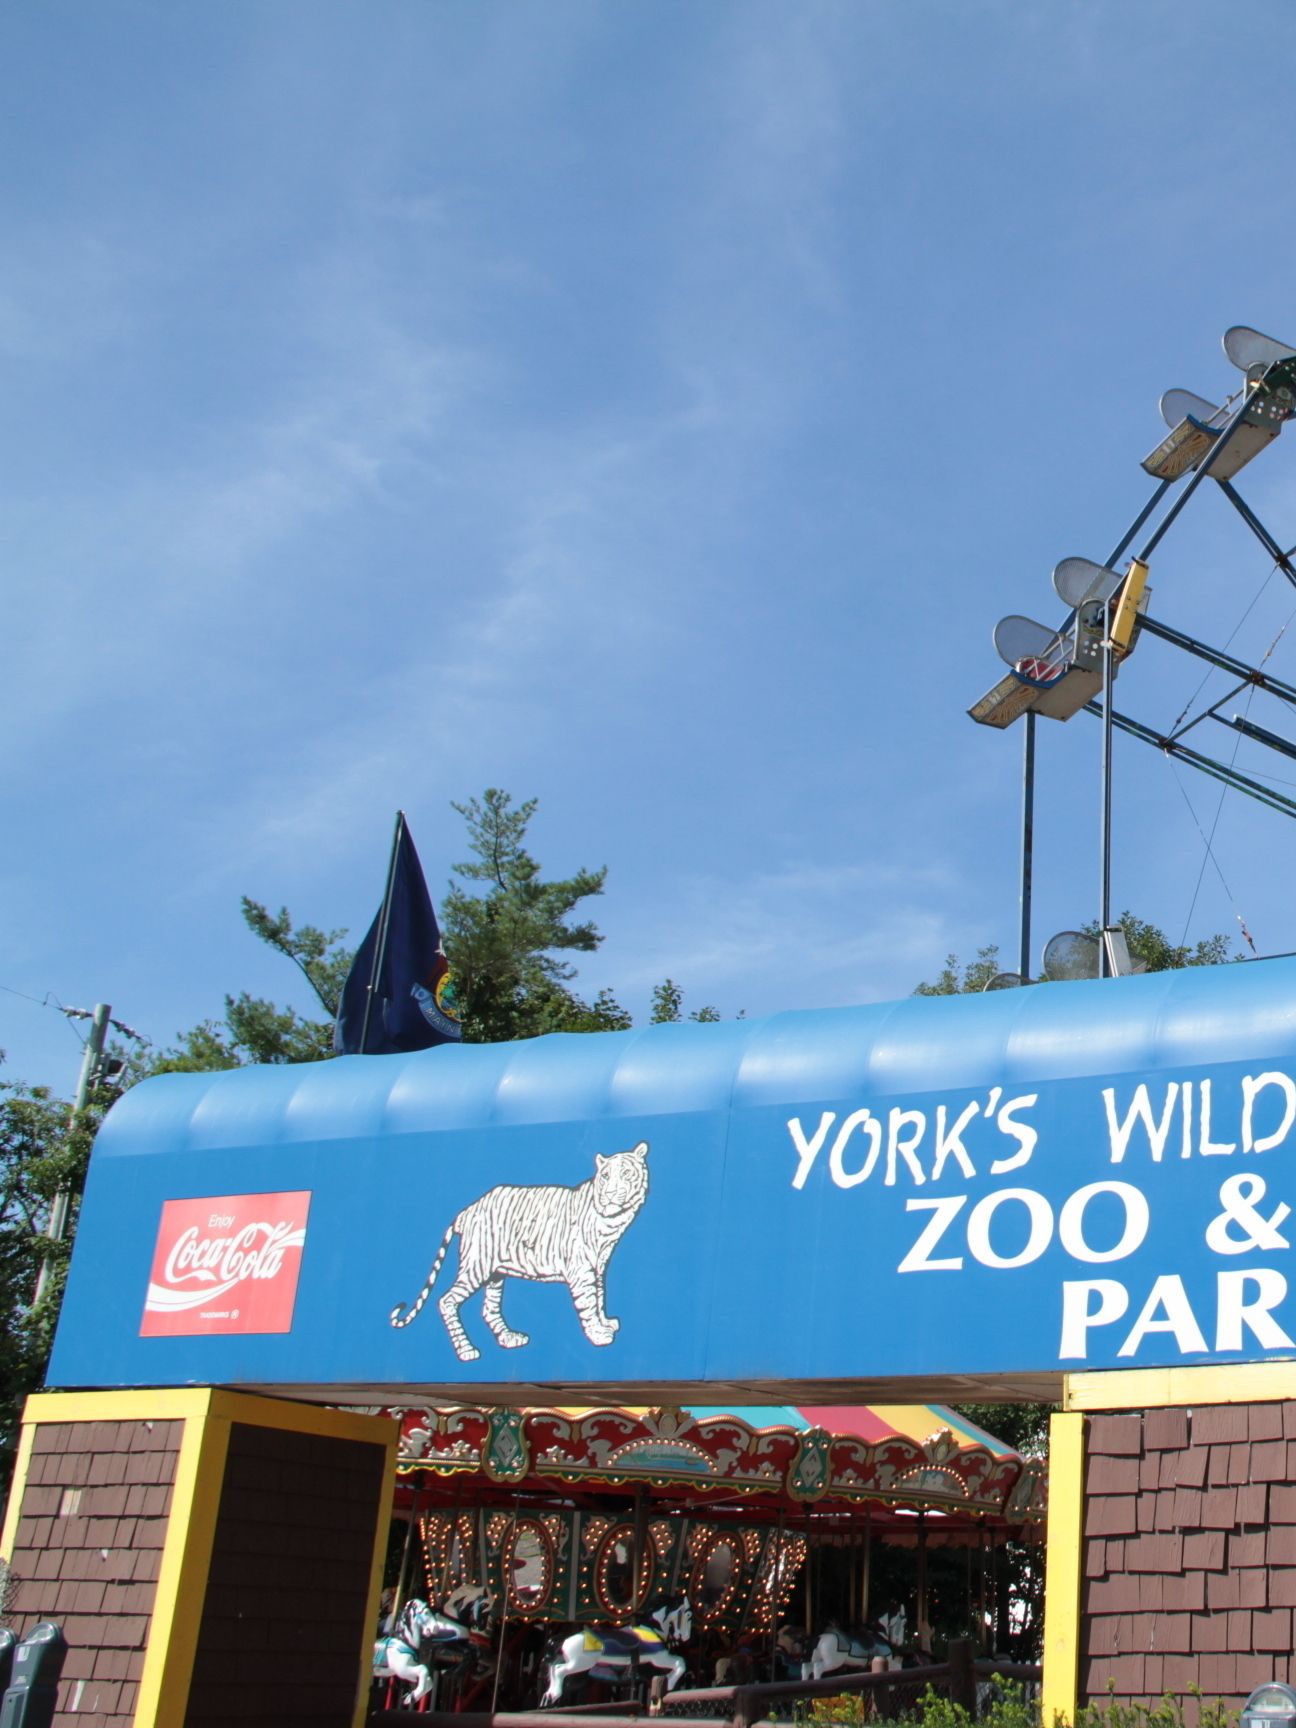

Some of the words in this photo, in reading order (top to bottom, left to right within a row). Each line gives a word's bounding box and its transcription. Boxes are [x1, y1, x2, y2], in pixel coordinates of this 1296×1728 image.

[787, 1086, 1038, 1190] YORK'S
[164, 1220, 293, 1284] Coca-Cola
[207, 1213, 236, 1230] Enjoy
[896, 1180, 1150, 1274] ZOO
[1205, 1172, 1292, 1256] &
